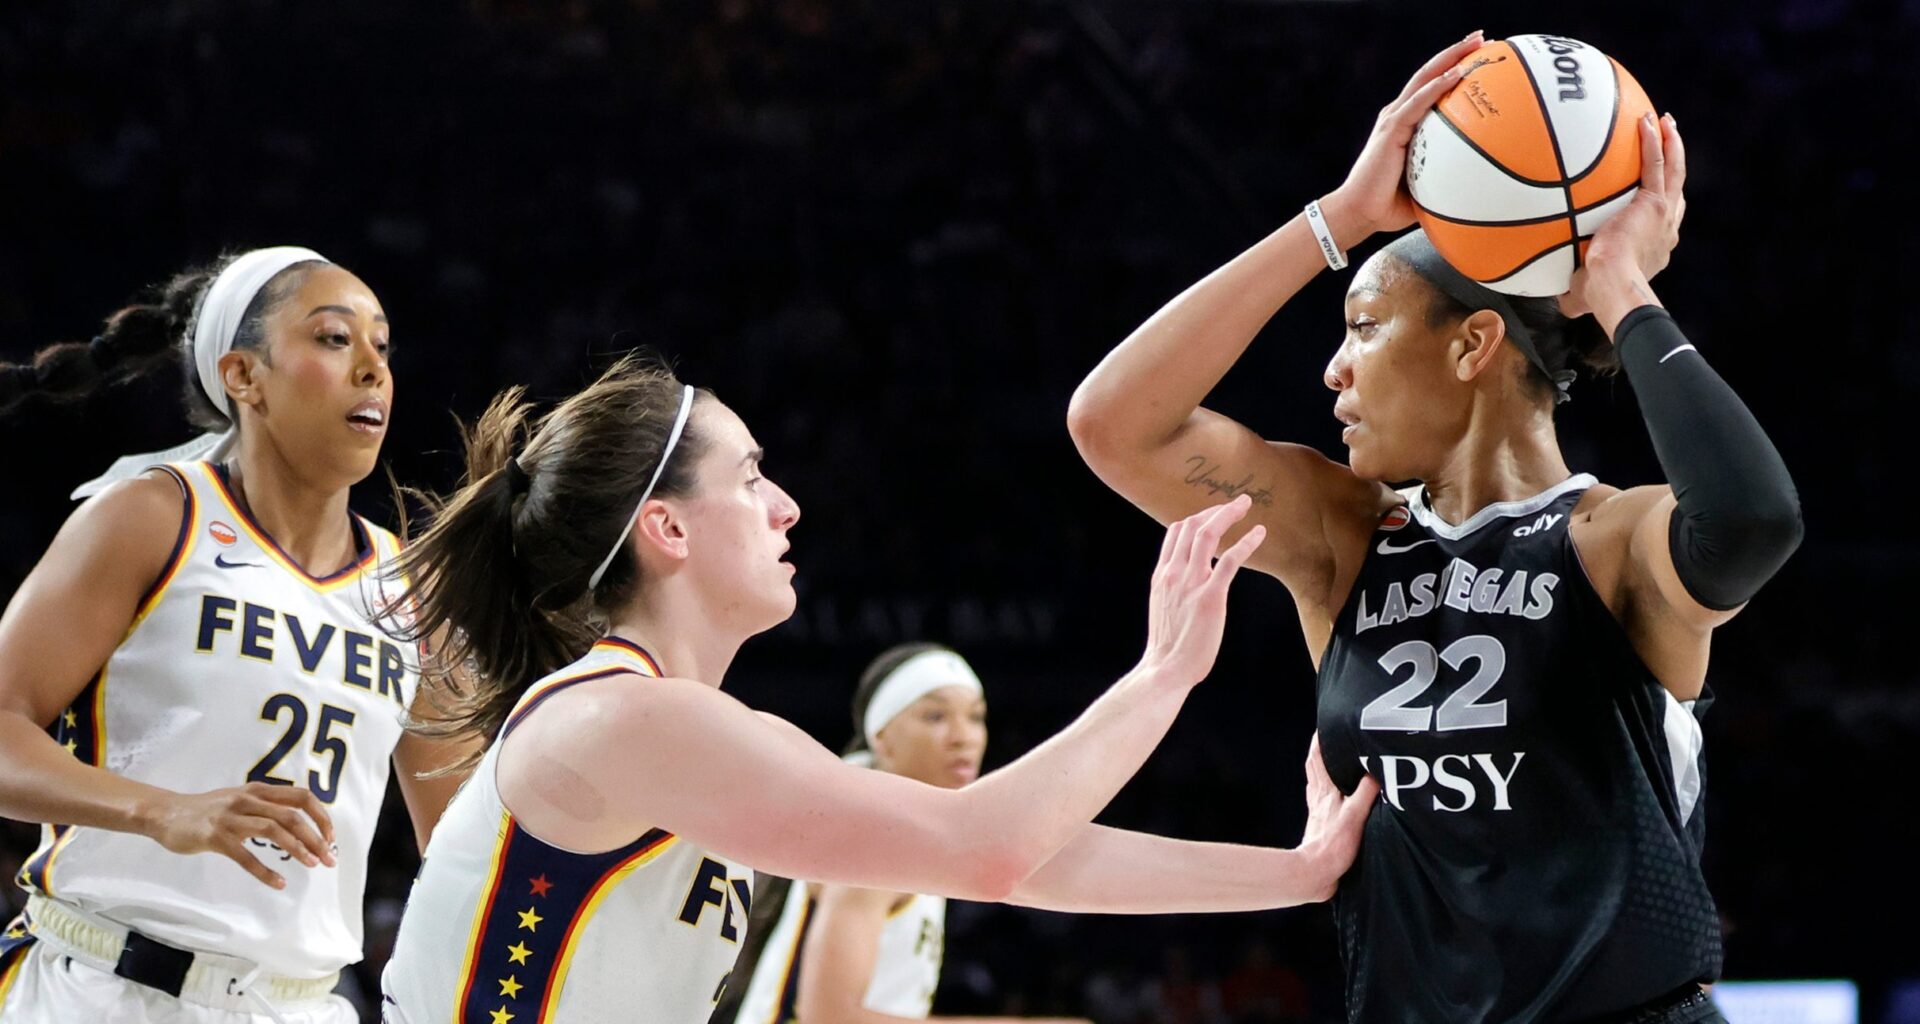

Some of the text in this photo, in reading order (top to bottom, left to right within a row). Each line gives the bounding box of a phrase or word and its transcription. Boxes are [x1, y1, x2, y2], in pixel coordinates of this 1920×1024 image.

[1537, 35, 1587, 103] lson
[1513, 513, 1564, 537] ally
[1356, 572, 1437, 635] LAS
[195, 593, 406, 702] FEVER
[1360, 635, 1508, 731] 22
[246, 692, 356, 805] 25
[1359, 752, 1526, 812] PSY
